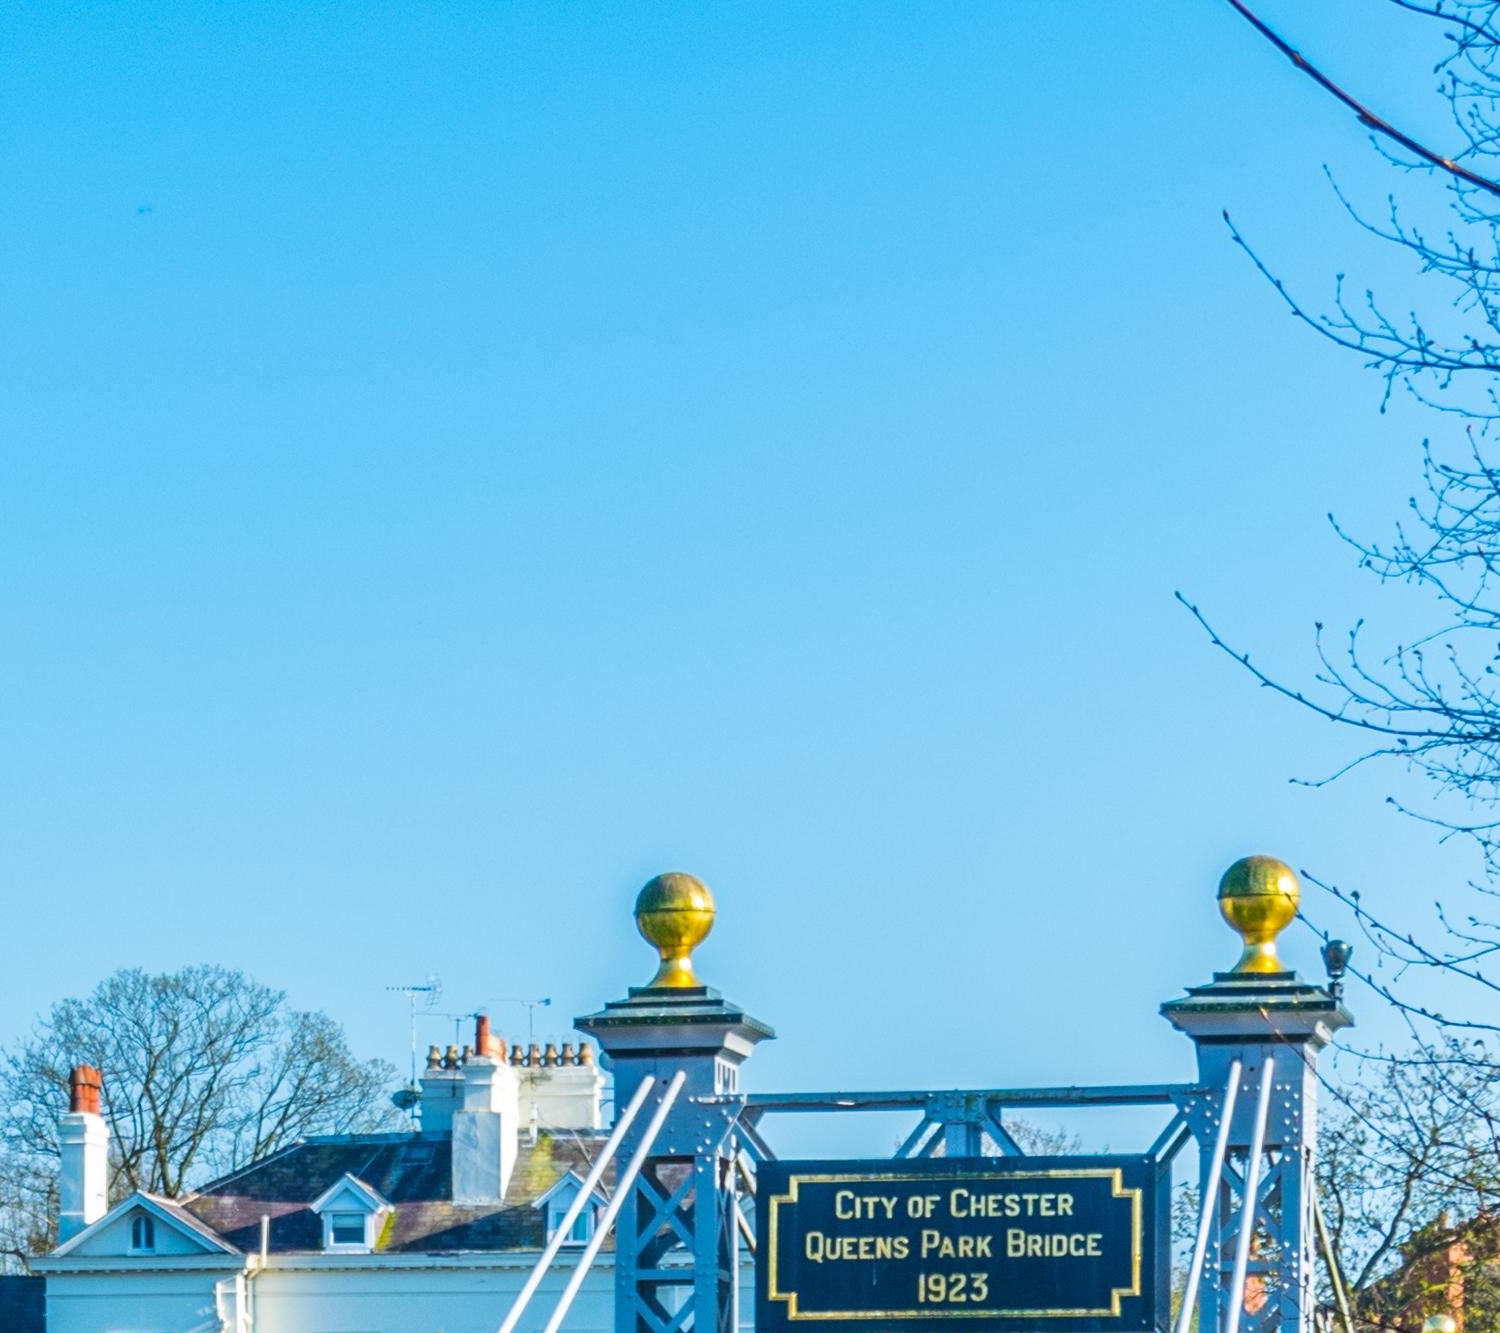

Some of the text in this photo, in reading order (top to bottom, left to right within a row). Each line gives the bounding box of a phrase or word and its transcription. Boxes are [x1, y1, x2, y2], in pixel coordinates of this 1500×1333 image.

[835, 1188, 1075, 1220] CITY OF CHESTER
[805, 1228, 1103, 1263] QUEENS PARK BRIDGE
[918, 1273, 989, 1303] 1923
